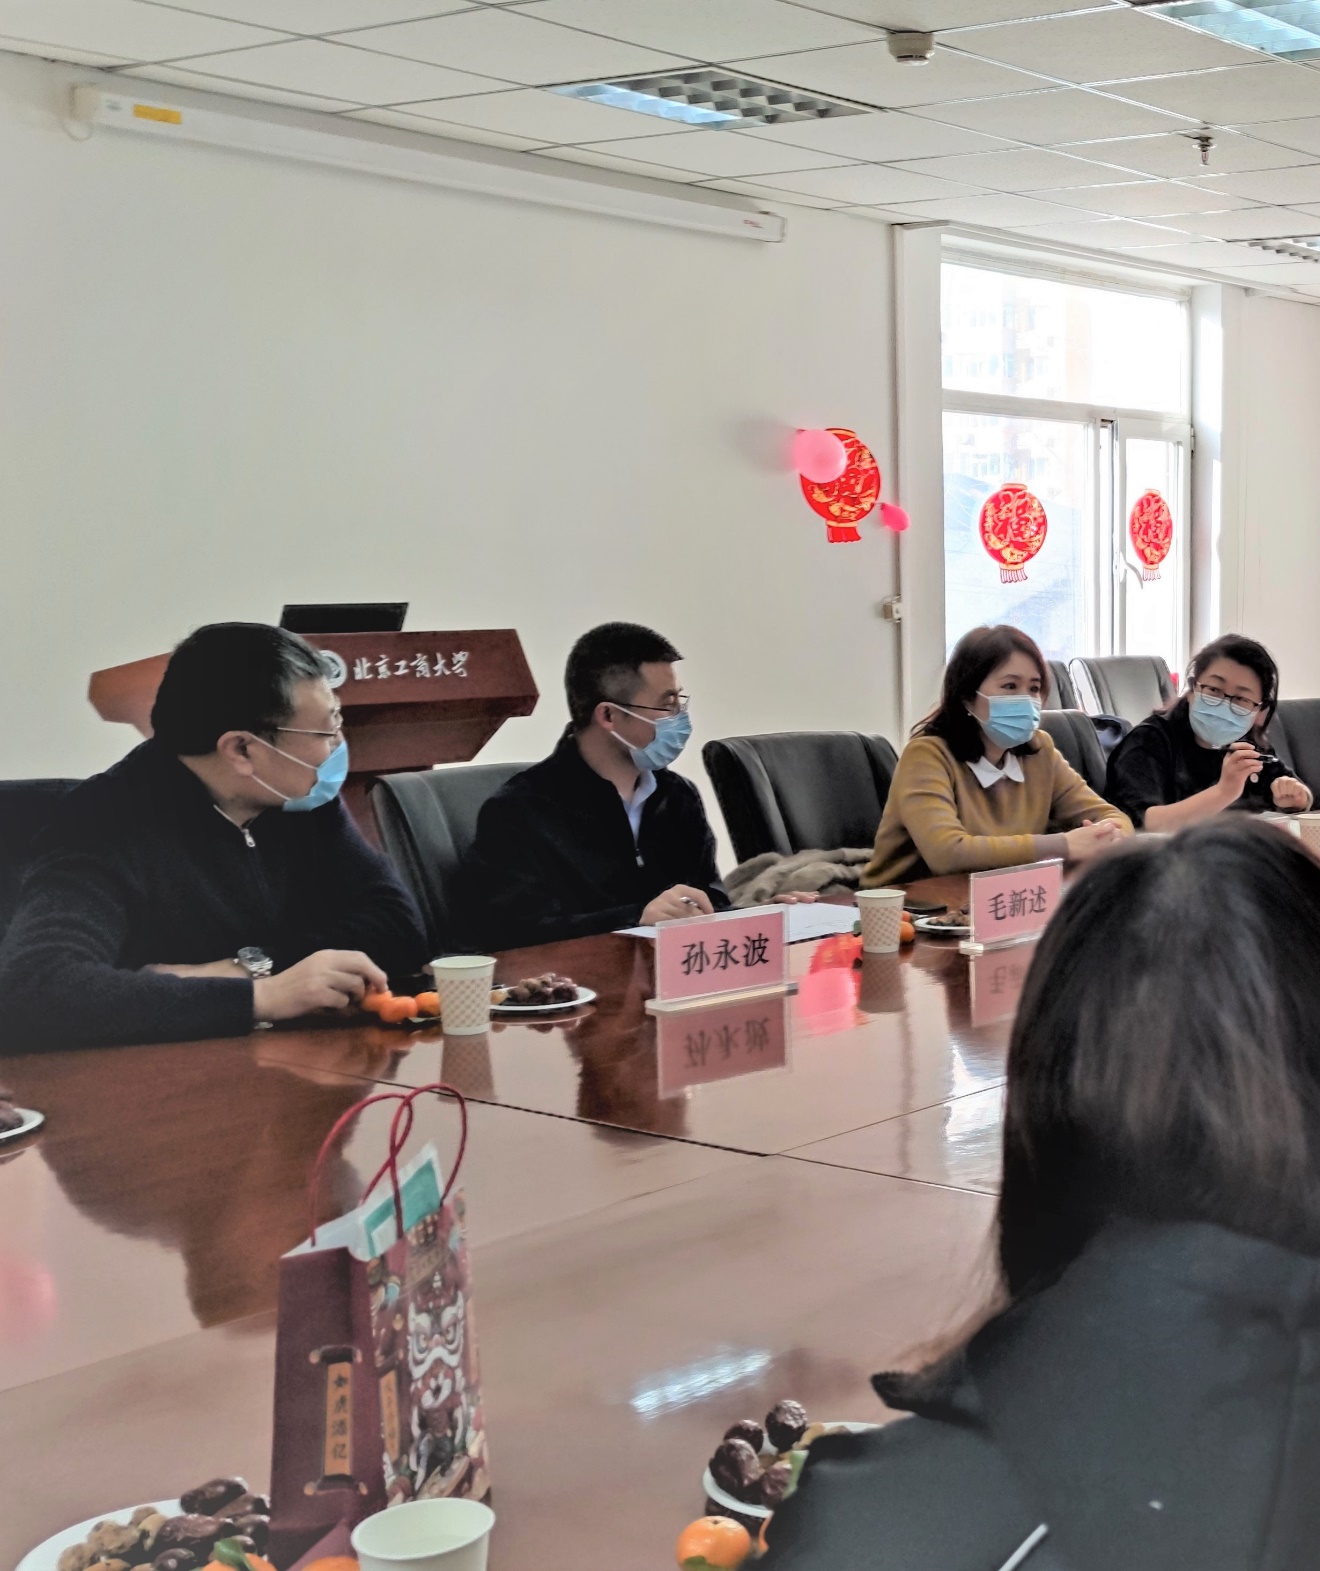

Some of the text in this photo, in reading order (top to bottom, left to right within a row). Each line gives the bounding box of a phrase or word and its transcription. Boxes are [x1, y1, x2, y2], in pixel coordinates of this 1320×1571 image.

[352, 650, 470, 681] 北京工商大学
[987, 884, 1048, 921] 毛新述
[680, 932, 771, 976] 孙永波
